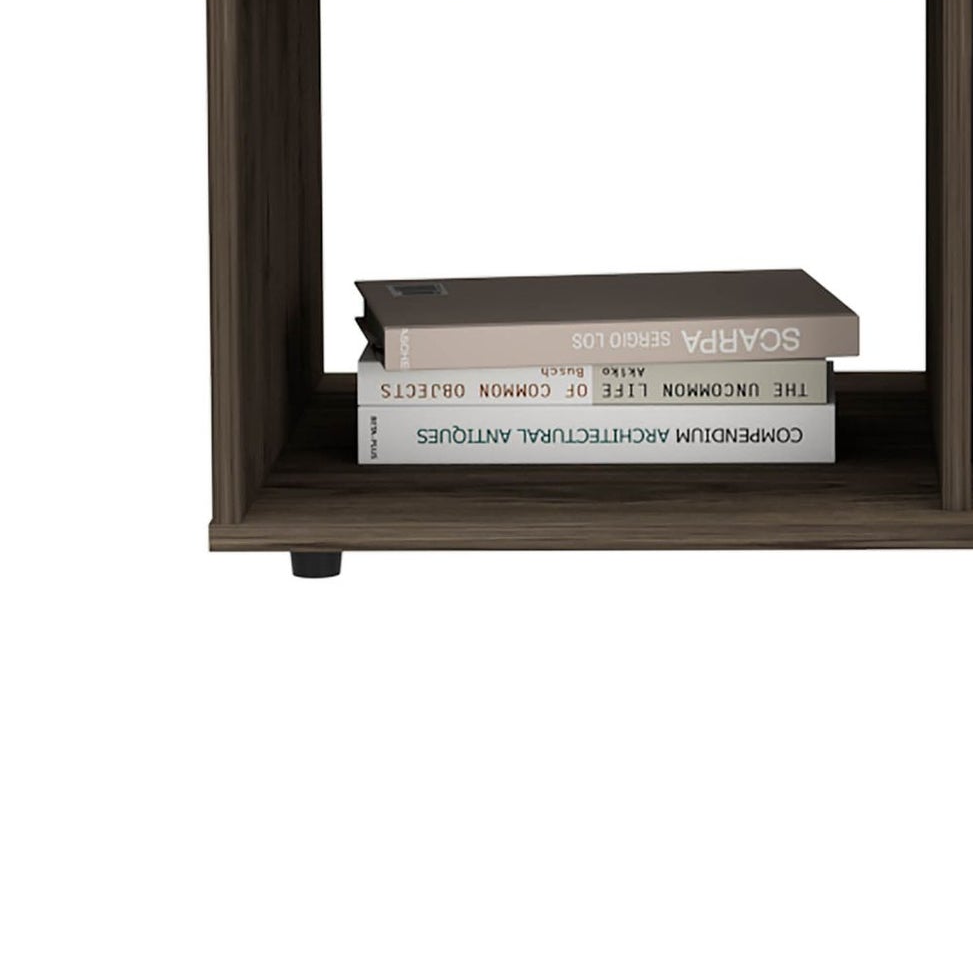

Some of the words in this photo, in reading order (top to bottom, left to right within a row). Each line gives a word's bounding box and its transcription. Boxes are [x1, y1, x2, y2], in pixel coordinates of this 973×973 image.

[571, 332, 604, 350] LOS
[609, 330, 671, 349] SERGIO
[681, 327, 801, 354] SCARPA
[541, 366, 585, 378] Busch
[602, 366, 646, 378] Akiko
[380, 383, 466, 399] OBJECTS
[479, 383, 552, 398] COMMON
[565, 383, 588, 398] OF
[602, 382, 647, 398] LIFE
[662, 382, 760, 398] UNCOMMON
[773, 382, 809, 398] THE
[416, 425, 511, 444] ANTIQUES
[517, 428, 670, 444] ARCHITECTURAL
[676, 427, 804, 444] COMPENDIUM
